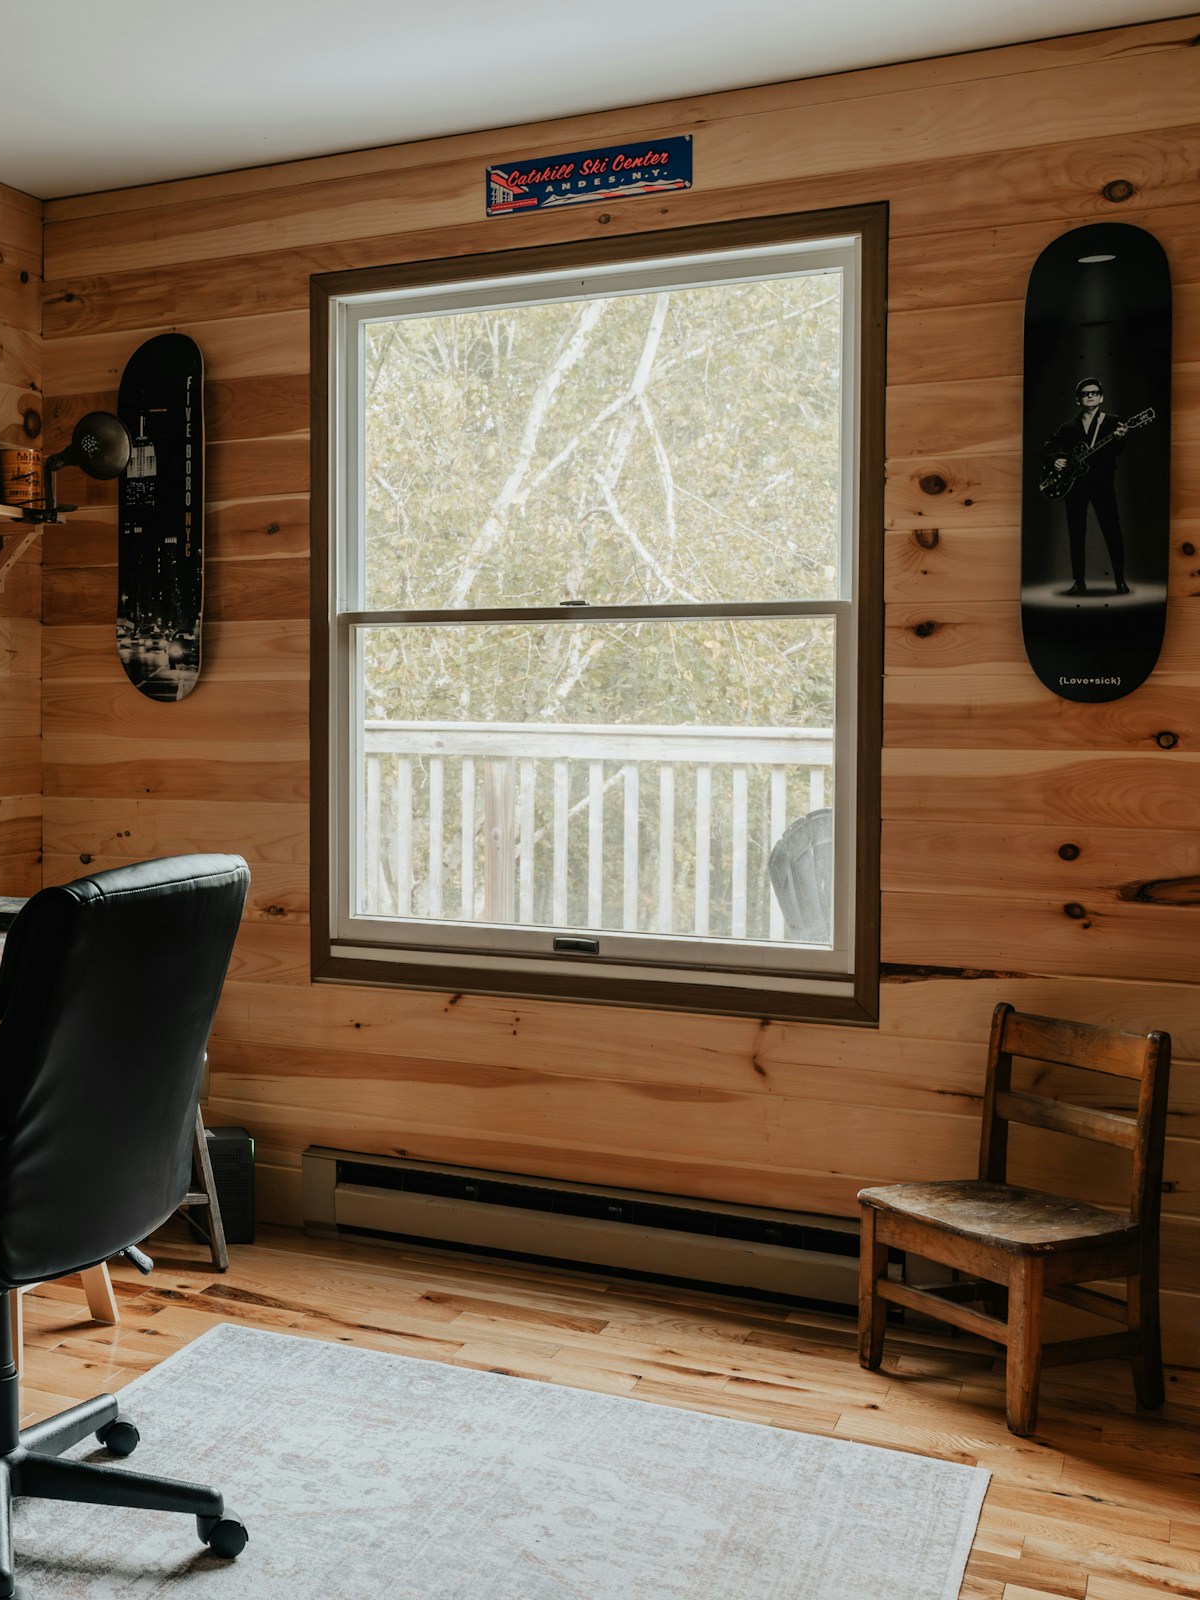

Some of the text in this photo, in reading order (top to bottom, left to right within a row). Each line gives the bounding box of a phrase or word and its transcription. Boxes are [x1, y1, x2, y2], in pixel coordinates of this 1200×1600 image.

[506, 150, 670, 187] Catskill Ski Center
[632, 169, 669, 180] N.Y.
[184, 511, 192, 558] NYC
